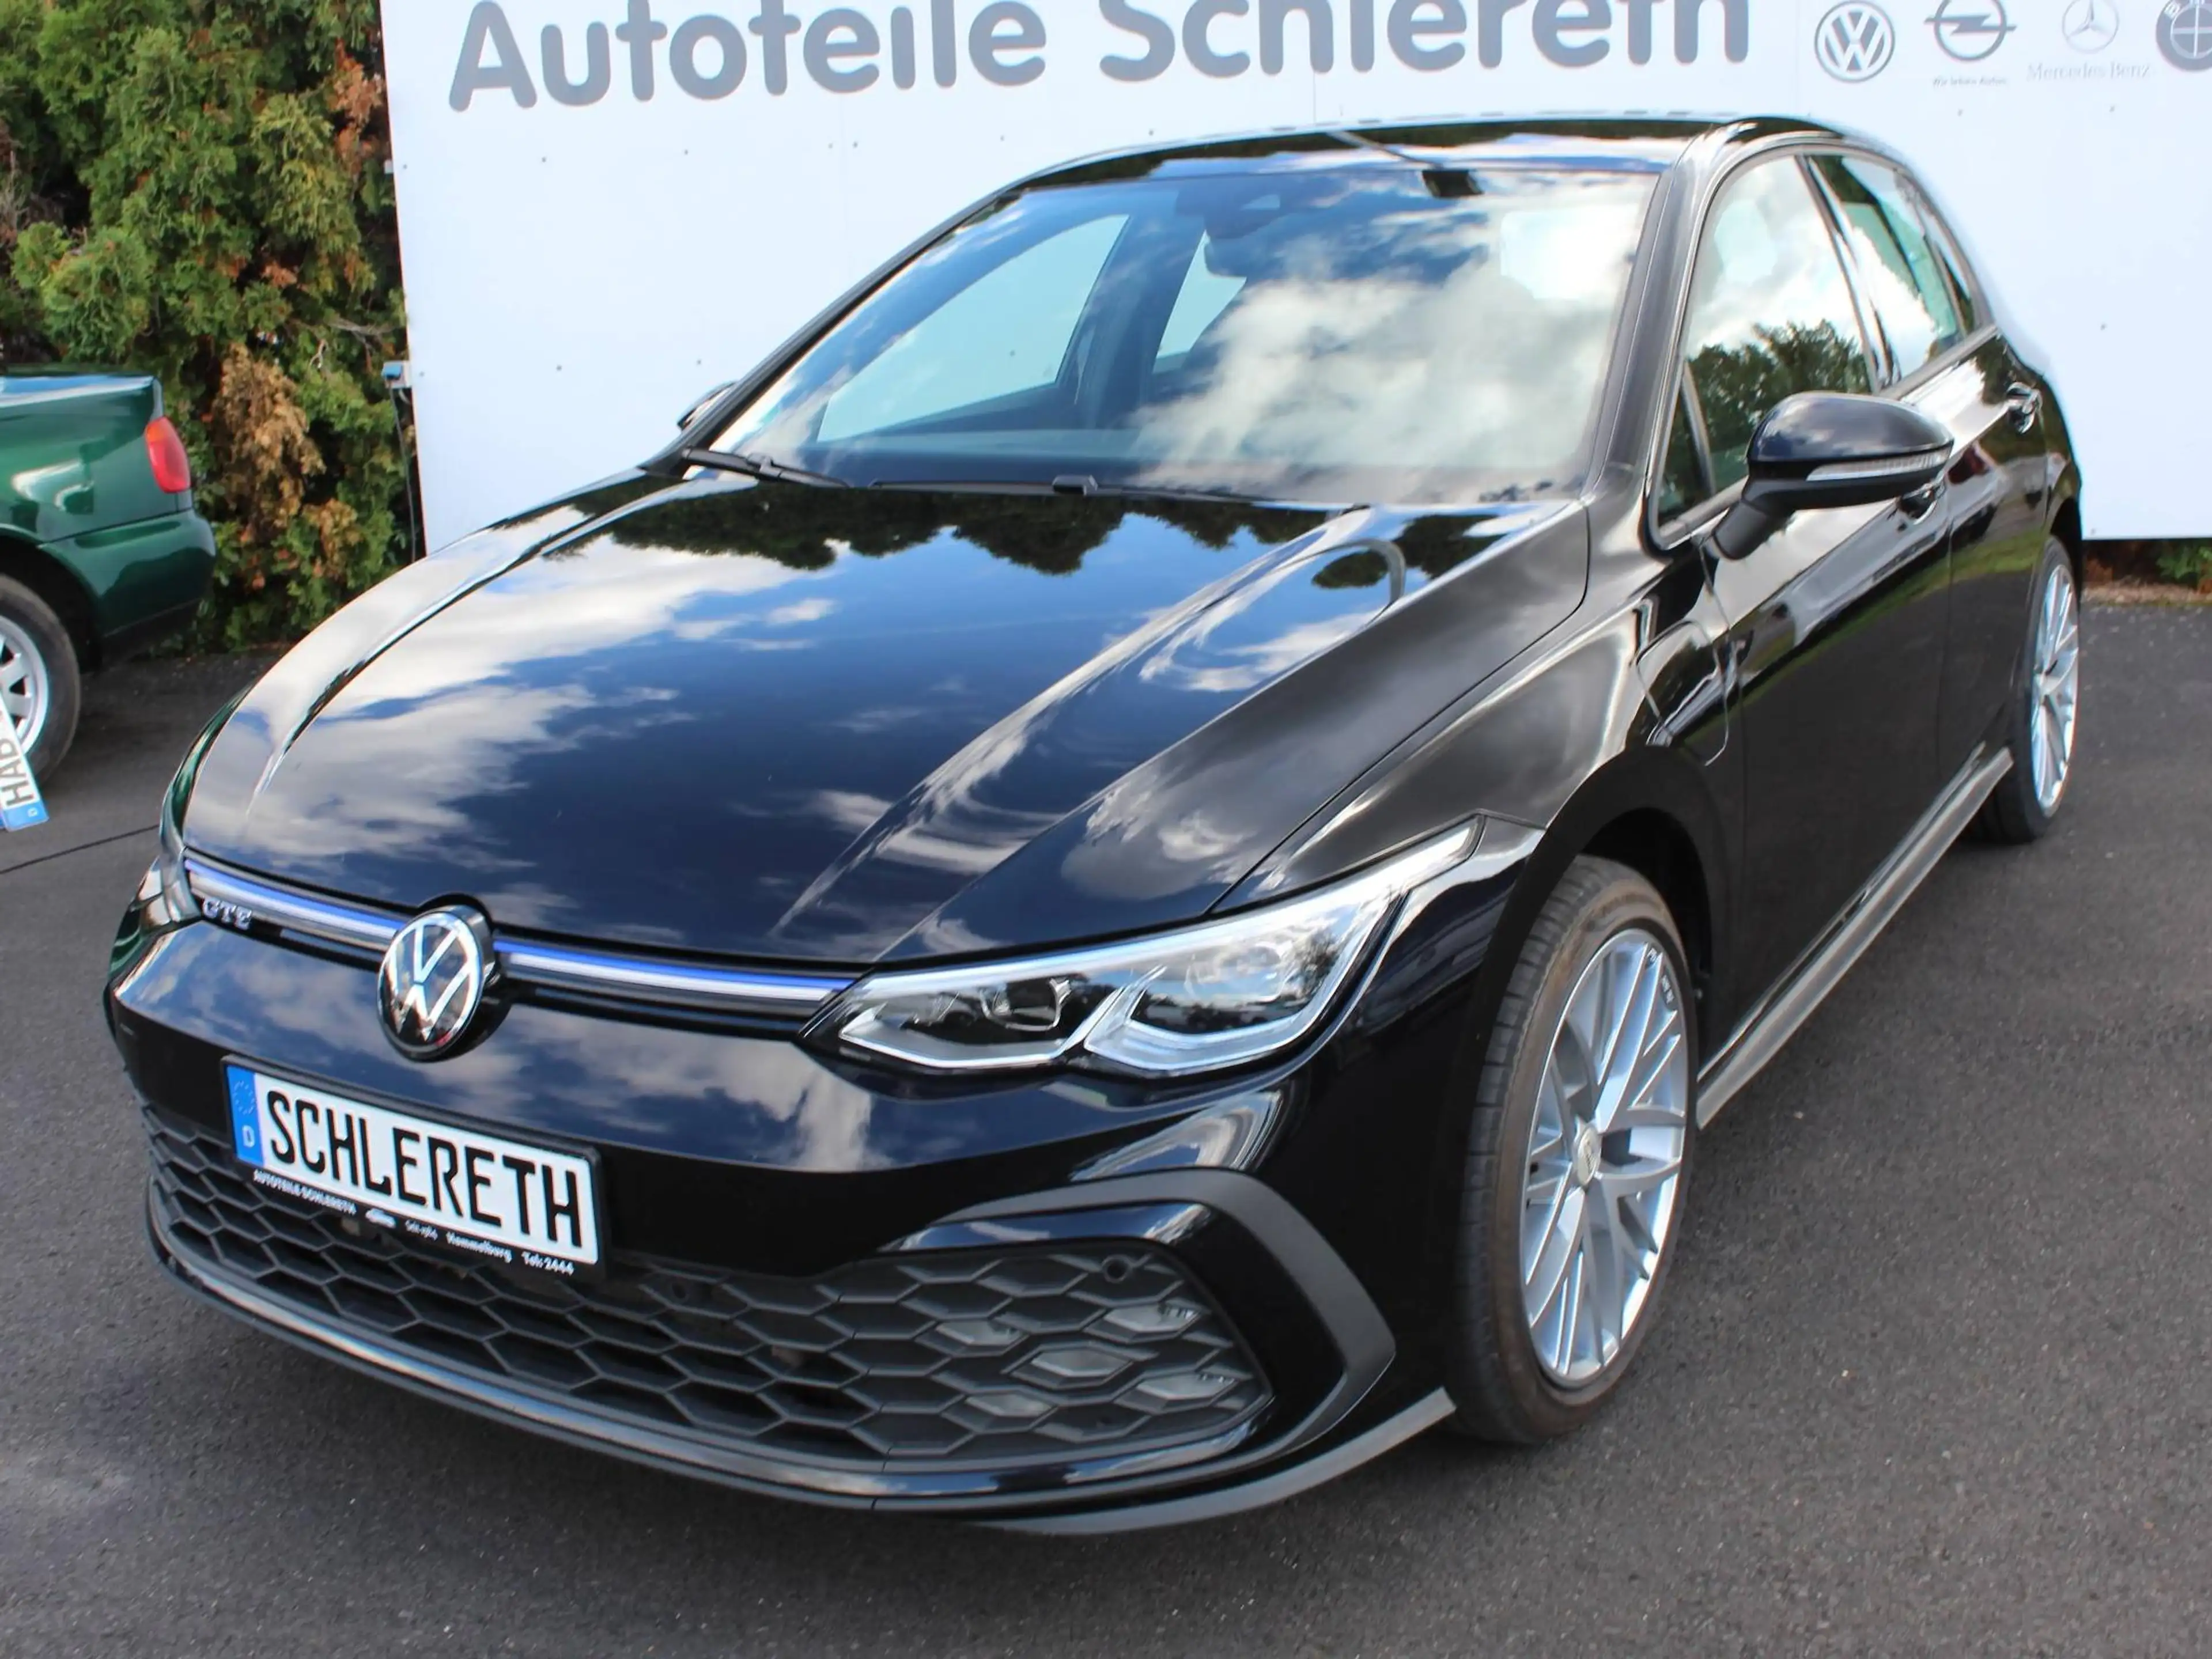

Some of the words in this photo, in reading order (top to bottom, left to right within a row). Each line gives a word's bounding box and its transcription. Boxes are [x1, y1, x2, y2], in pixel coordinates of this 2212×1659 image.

[448, 0, 1048, 112] Autoteile
[1098, 0, 1749, 81] Schlereth
[203, 899, 252, 931] GTE
[242, 1125, 255, 1147] D
[267, 1090, 582, 1248] SCHLERETH
